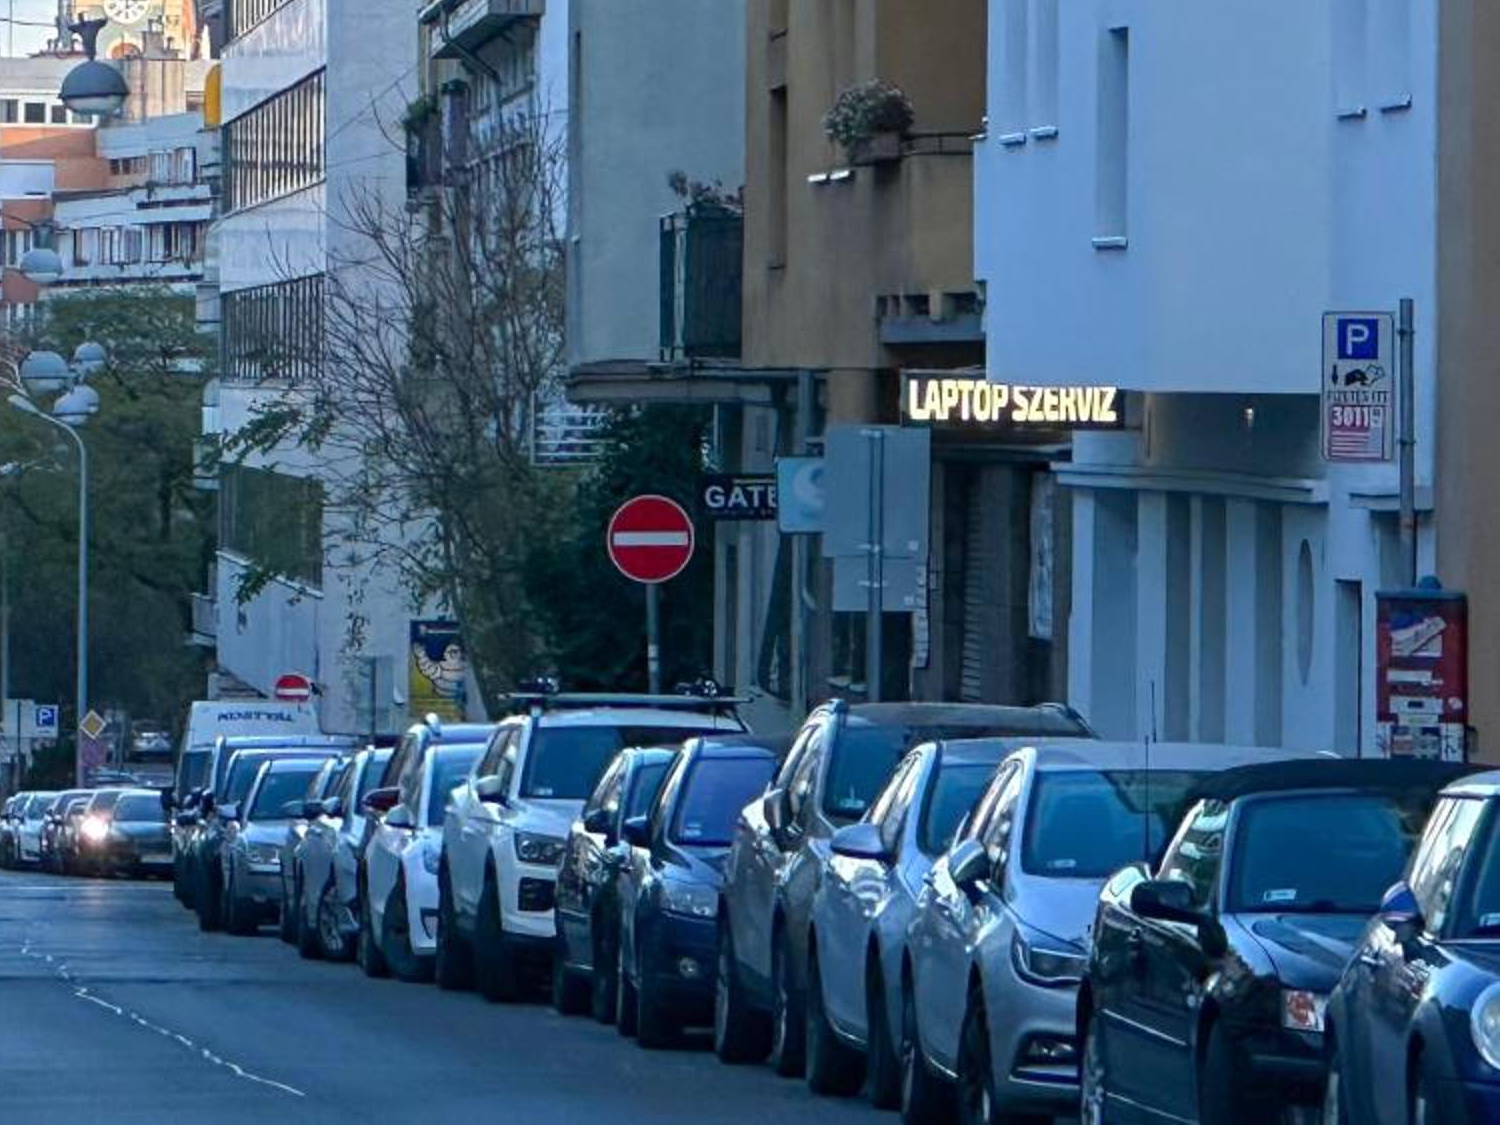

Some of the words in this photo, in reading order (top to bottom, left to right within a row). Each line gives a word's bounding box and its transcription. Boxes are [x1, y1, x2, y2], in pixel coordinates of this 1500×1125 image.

[1345, 323, 1370, 356] P
[909, 379, 1009, 422] LAPTOP
[1011, 386, 1117, 422] SZERVIZ
[1332, 406, 1369, 427] 3011
